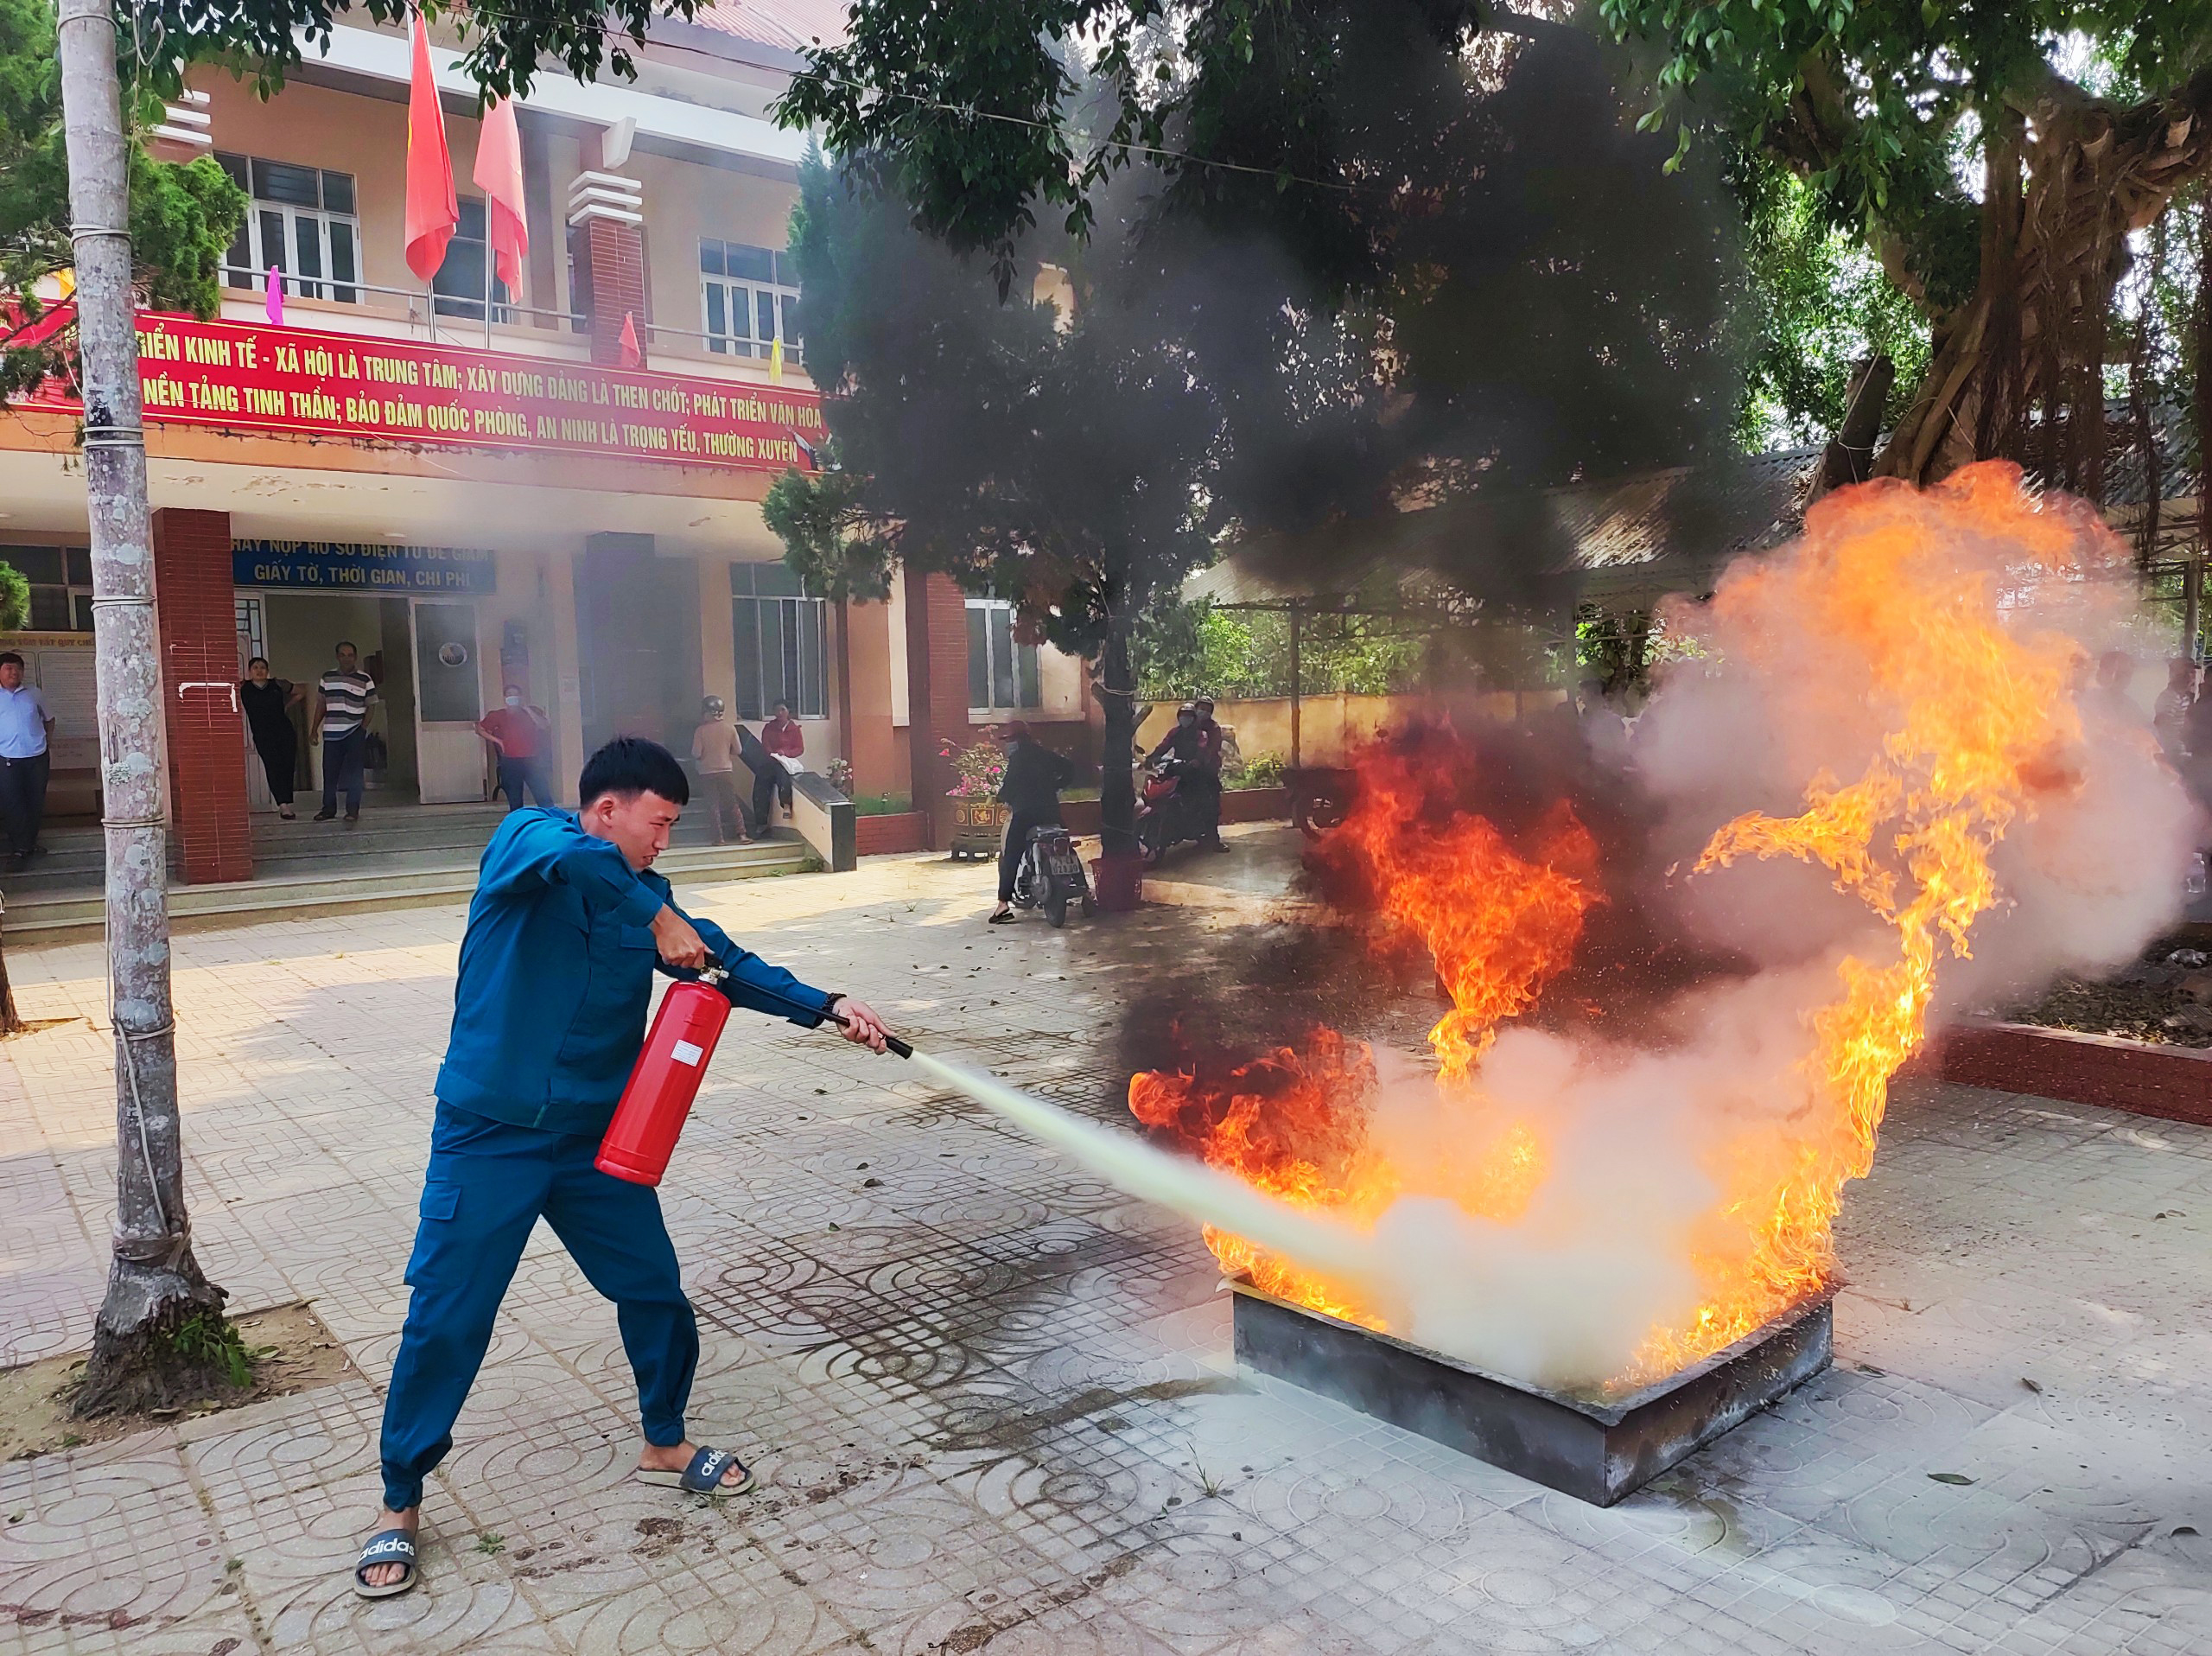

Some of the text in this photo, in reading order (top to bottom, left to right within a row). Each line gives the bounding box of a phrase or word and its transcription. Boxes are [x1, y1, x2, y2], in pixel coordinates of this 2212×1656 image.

[135, 322, 180, 361] RIỂN
[184, 335, 232, 367] KINH
[235, 334, 257, 370] TẾ
[275, 343, 300, 373] XÃ
[304, 345, 334, 382] HỘI
[338, 348, 360, 380] LÀ
[363, 355, 418, 386] TRUNG
[422, 358, 463, 393] TÂM;
[467, 363, 497, 394] XÂY
[501, 370, 543, 402] DỰNG
[547, 370, 588, 404] ĐẢNG
[591, 378, 610, 406] LÀ
[612, 383, 649, 410] THEN
[652, 383, 690, 417] CHỐT;
[693, 391, 727, 418] PHÁT
[729, 392, 767, 423] TRIỂN
[769, 400, 795, 427] VĂN
[797, 403, 823, 430] HÓA
[143, 370, 798, 463] NỀN TẢNG TINH THẦN; BẢO ĐẢM QUỐC PHÒNG, AN NINH LÀ TRỌNG YẾU, THƯỜNG XUYÊN
[254, 558, 291, 582] GIẤY
[296, 562, 324, 585] TỜ,
[327, 564, 365, 583] THỜI
[370, 569, 411, 588] GIAN,
[415, 570, 441, 587] CHI
[356, 1538, 415, 1563] adidas
